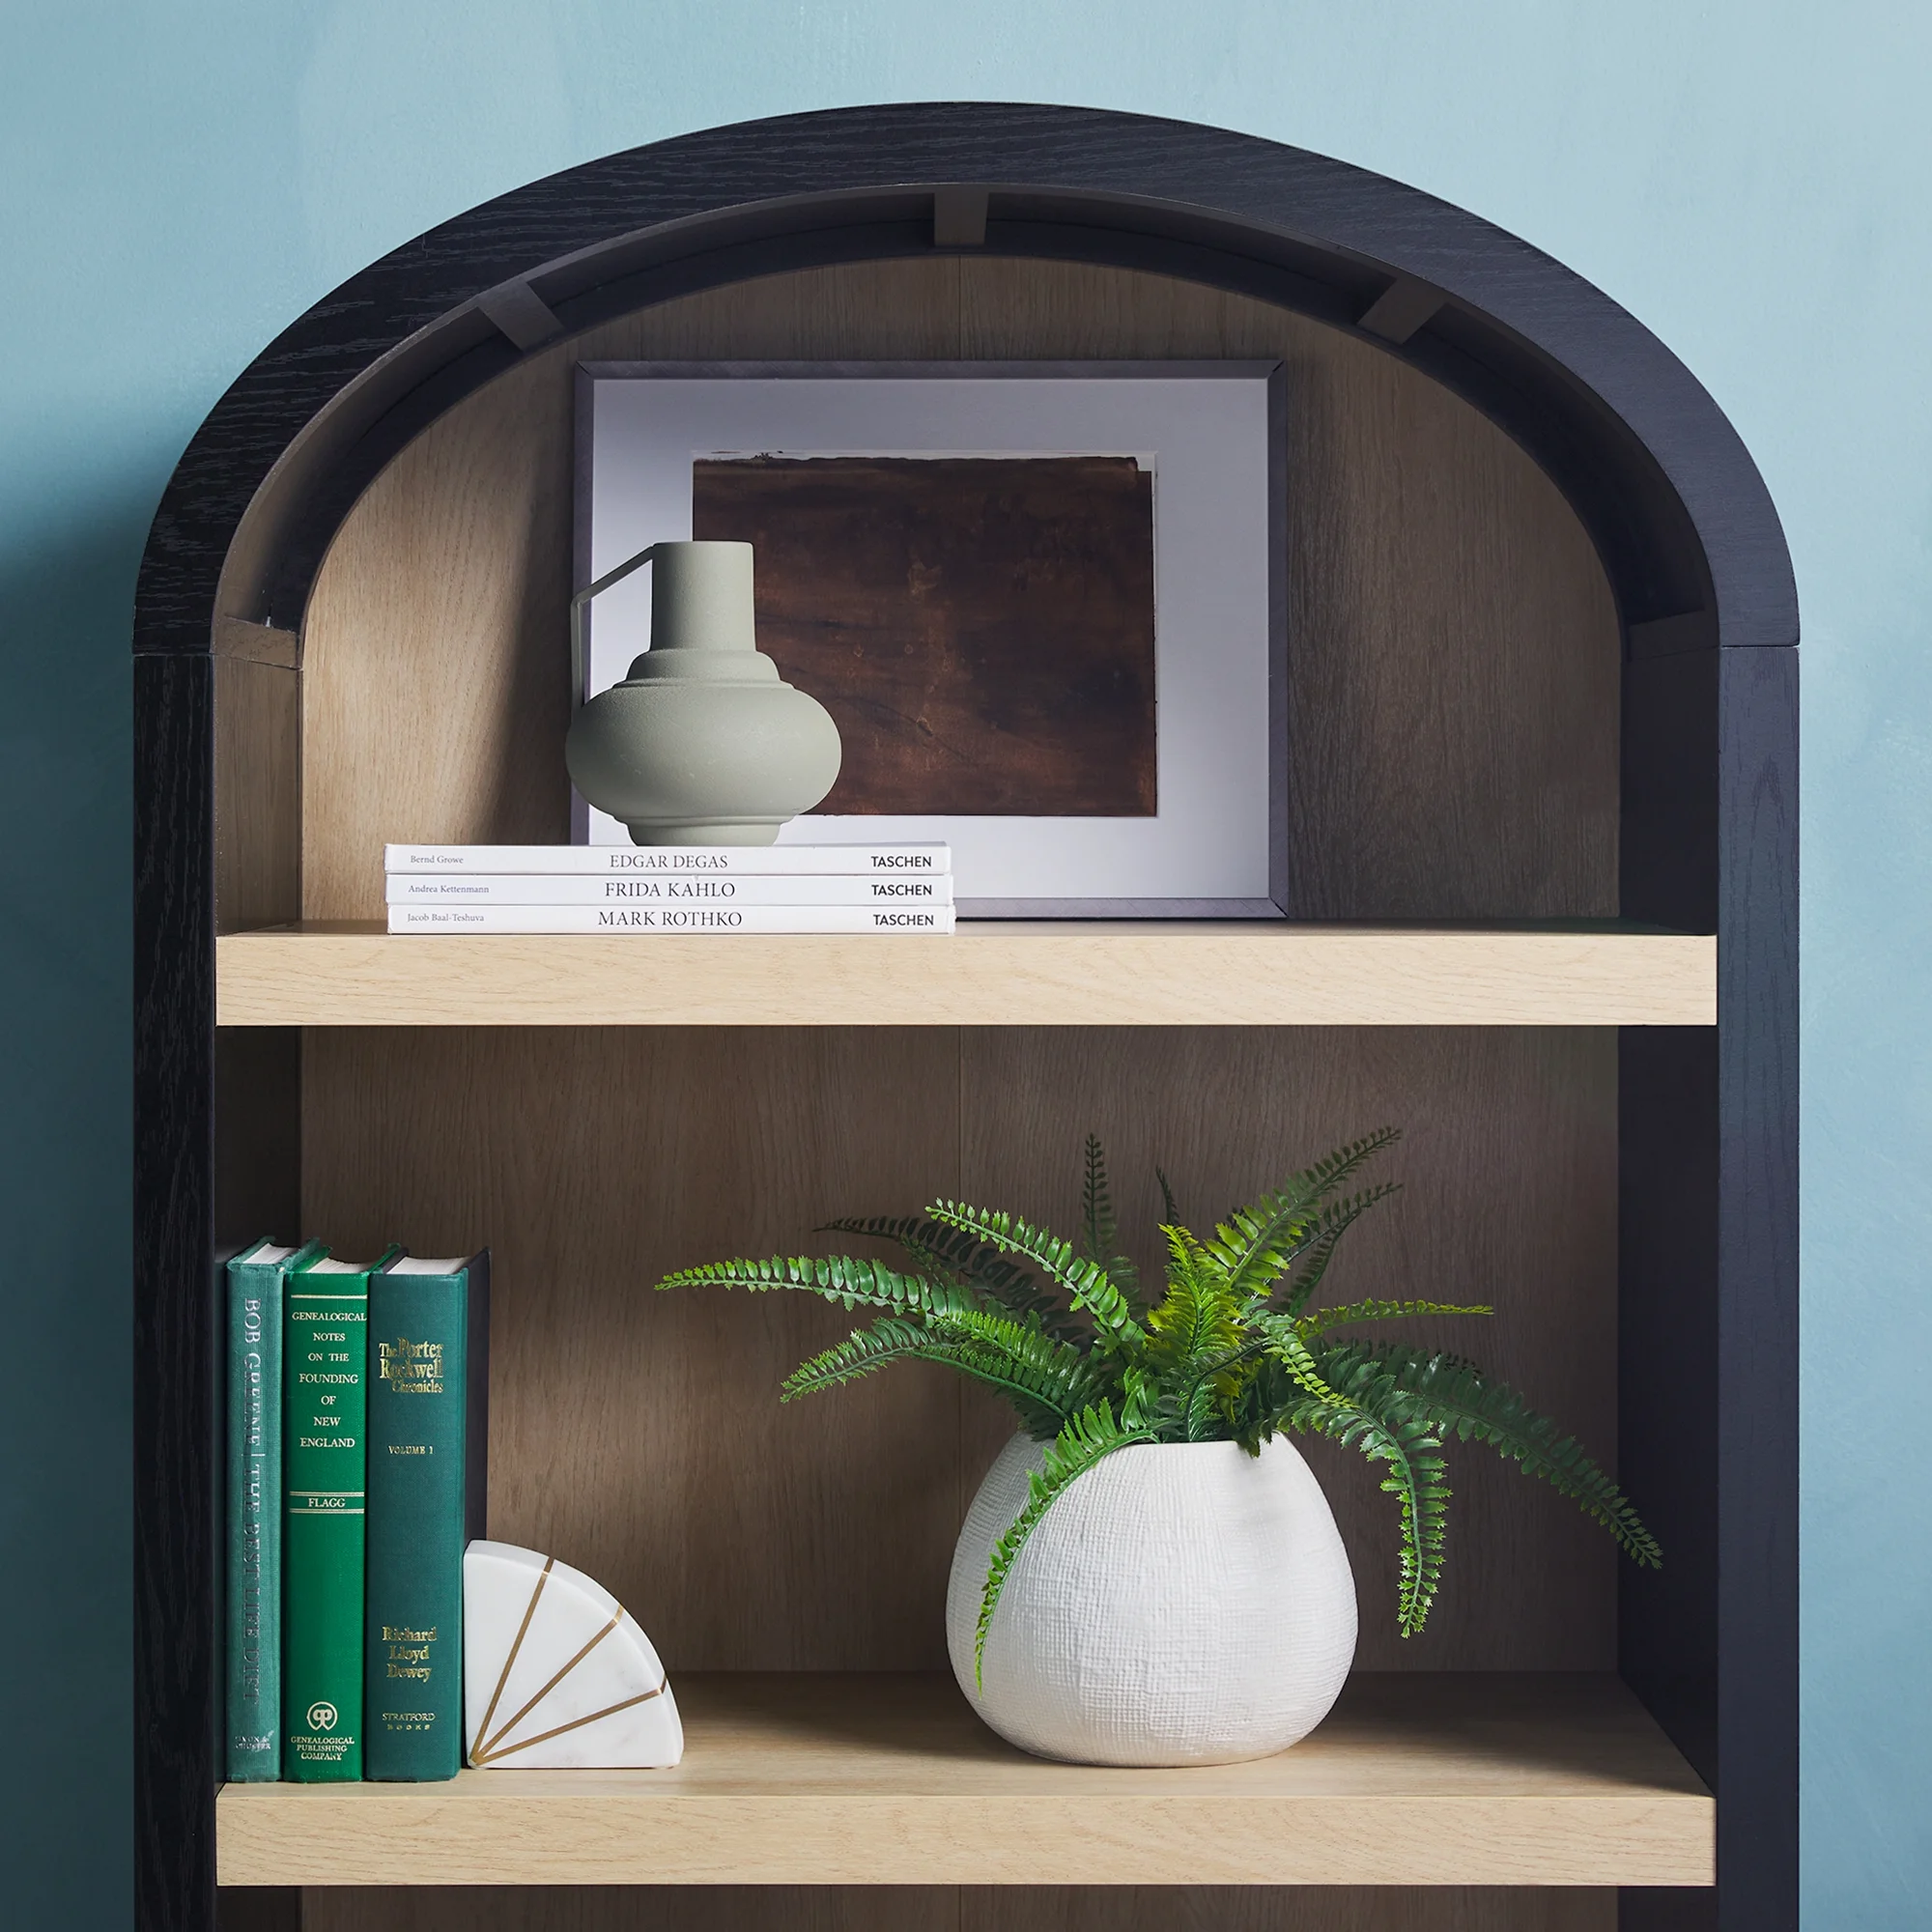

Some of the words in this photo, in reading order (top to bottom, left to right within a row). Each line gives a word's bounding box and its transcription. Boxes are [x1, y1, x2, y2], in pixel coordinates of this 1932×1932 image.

[410, 854, 435, 865] Bernd
[437, 854, 464, 865] Growe
[610, 855, 668, 868] EDGAR
[673, 855, 728, 868] DEGAS
[871, 856, 932, 867] TASCHEN
[408, 885, 438, 894] Andrea
[440, 885, 490, 894] Kettenmann
[605, 882, 662, 897] FRIDA
[668, 882, 735, 897] KAHLO
[871, 884, 932, 896] TASCHEN
[407, 913, 430, 923] Jacob
[432, 913, 485, 923] Baal-Teshuva
[598, 911, 656, 926] MARK
[662, 911, 743, 926] ROTHKO
[873, 914, 934, 926] TASCHEN
[244, 1298, 262, 1344] BOB
[292, 1312, 367, 1321] GENEALOGICAL
[313, 1332, 346, 1342] NOTES
[379, 1343, 398, 1358] The
[397, 1337, 443, 1358] Porter
[307, 1352, 323, 1362] ON
[328, 1352, 350, 1362] THE
[379, 1358, 443, 1379] Rockwell
[298, 1374, 358, 1384] FOUNDING
[391, 1378, 443, 1394] Chronicles
[243, 1352, 262, 1446] GREENE
[321, 1396, 336, 1406] OF
[313, 1416, 341, 1427] NEW
[299, 1437, 355, 1448] ENGLAND
[388, 1445, 426, 1455] VOLUME
[243, 1463, 261, 1513] THE
[308, 1498, 346, 1508] FLAGG
[243, 1522, 261, 1580] BEST
[243, 1587, 261, 1639] LIFE
[382, 1626, 438, 1642] Richard
[389, 1645, 430, 1664] Lloyd
[243, 1646, 260, 1705] DIET
[386, 1662, 432, 1683] Dewey
[382, 1713, 436, 1721] STRATFORD
[291, 1736, 355, 1745] GENEALOGICAL
[300, 1752, 342, 1761] COMPANY
